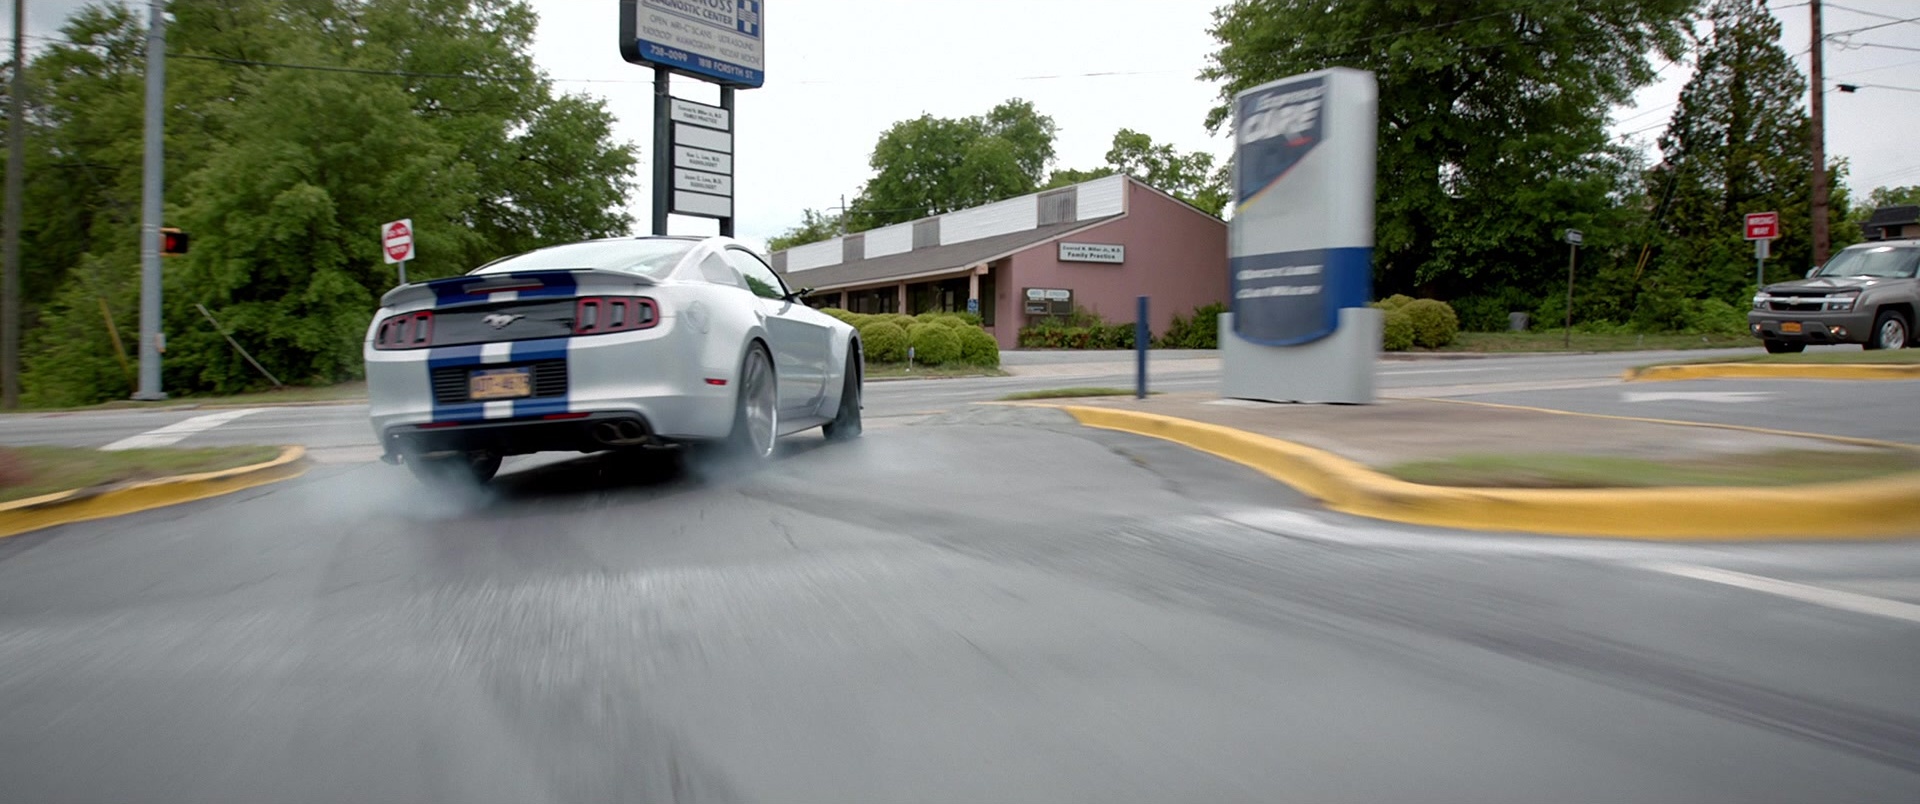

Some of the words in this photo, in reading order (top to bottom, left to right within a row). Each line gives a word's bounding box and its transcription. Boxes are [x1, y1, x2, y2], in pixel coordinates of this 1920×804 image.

[703, 9, 733, 25] CENTER
[713, 61, 744, 76] FORSYTH
[1749, 216, 1775, 225] WRONG
[387, 229, 397, 237] DO
[1752, 226, 1770, 235] WAY
[390, 245, 408, 255] ENTER
